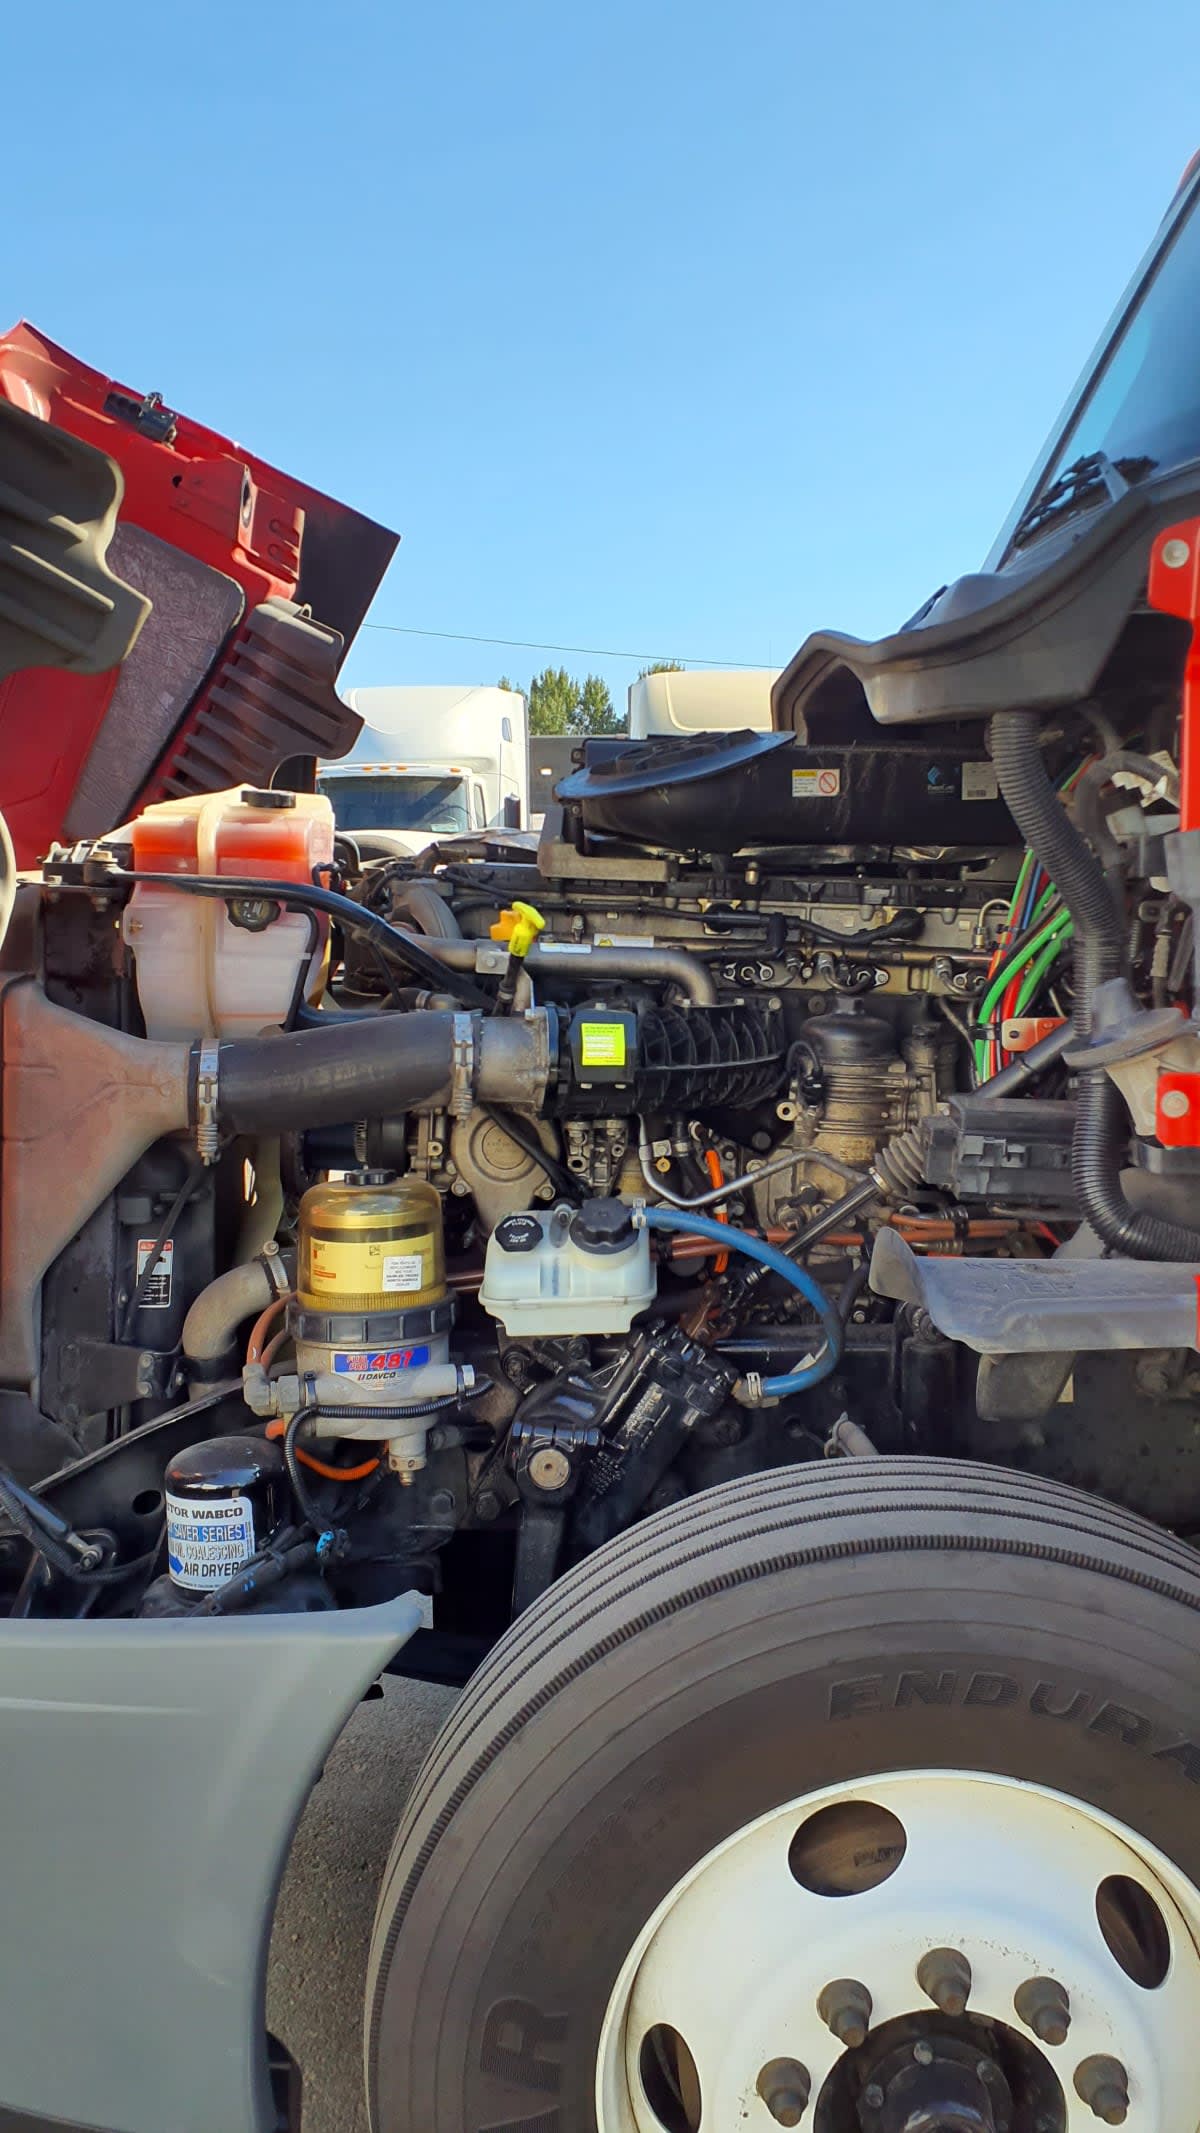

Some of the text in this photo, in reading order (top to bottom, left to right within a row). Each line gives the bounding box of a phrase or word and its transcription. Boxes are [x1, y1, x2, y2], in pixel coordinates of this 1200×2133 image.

[192, 1508, 243, 1519] WABCO
[174, 1525, 243, 1541] SAVER SERIES
[184, 1562, 199, 1577] AIR
